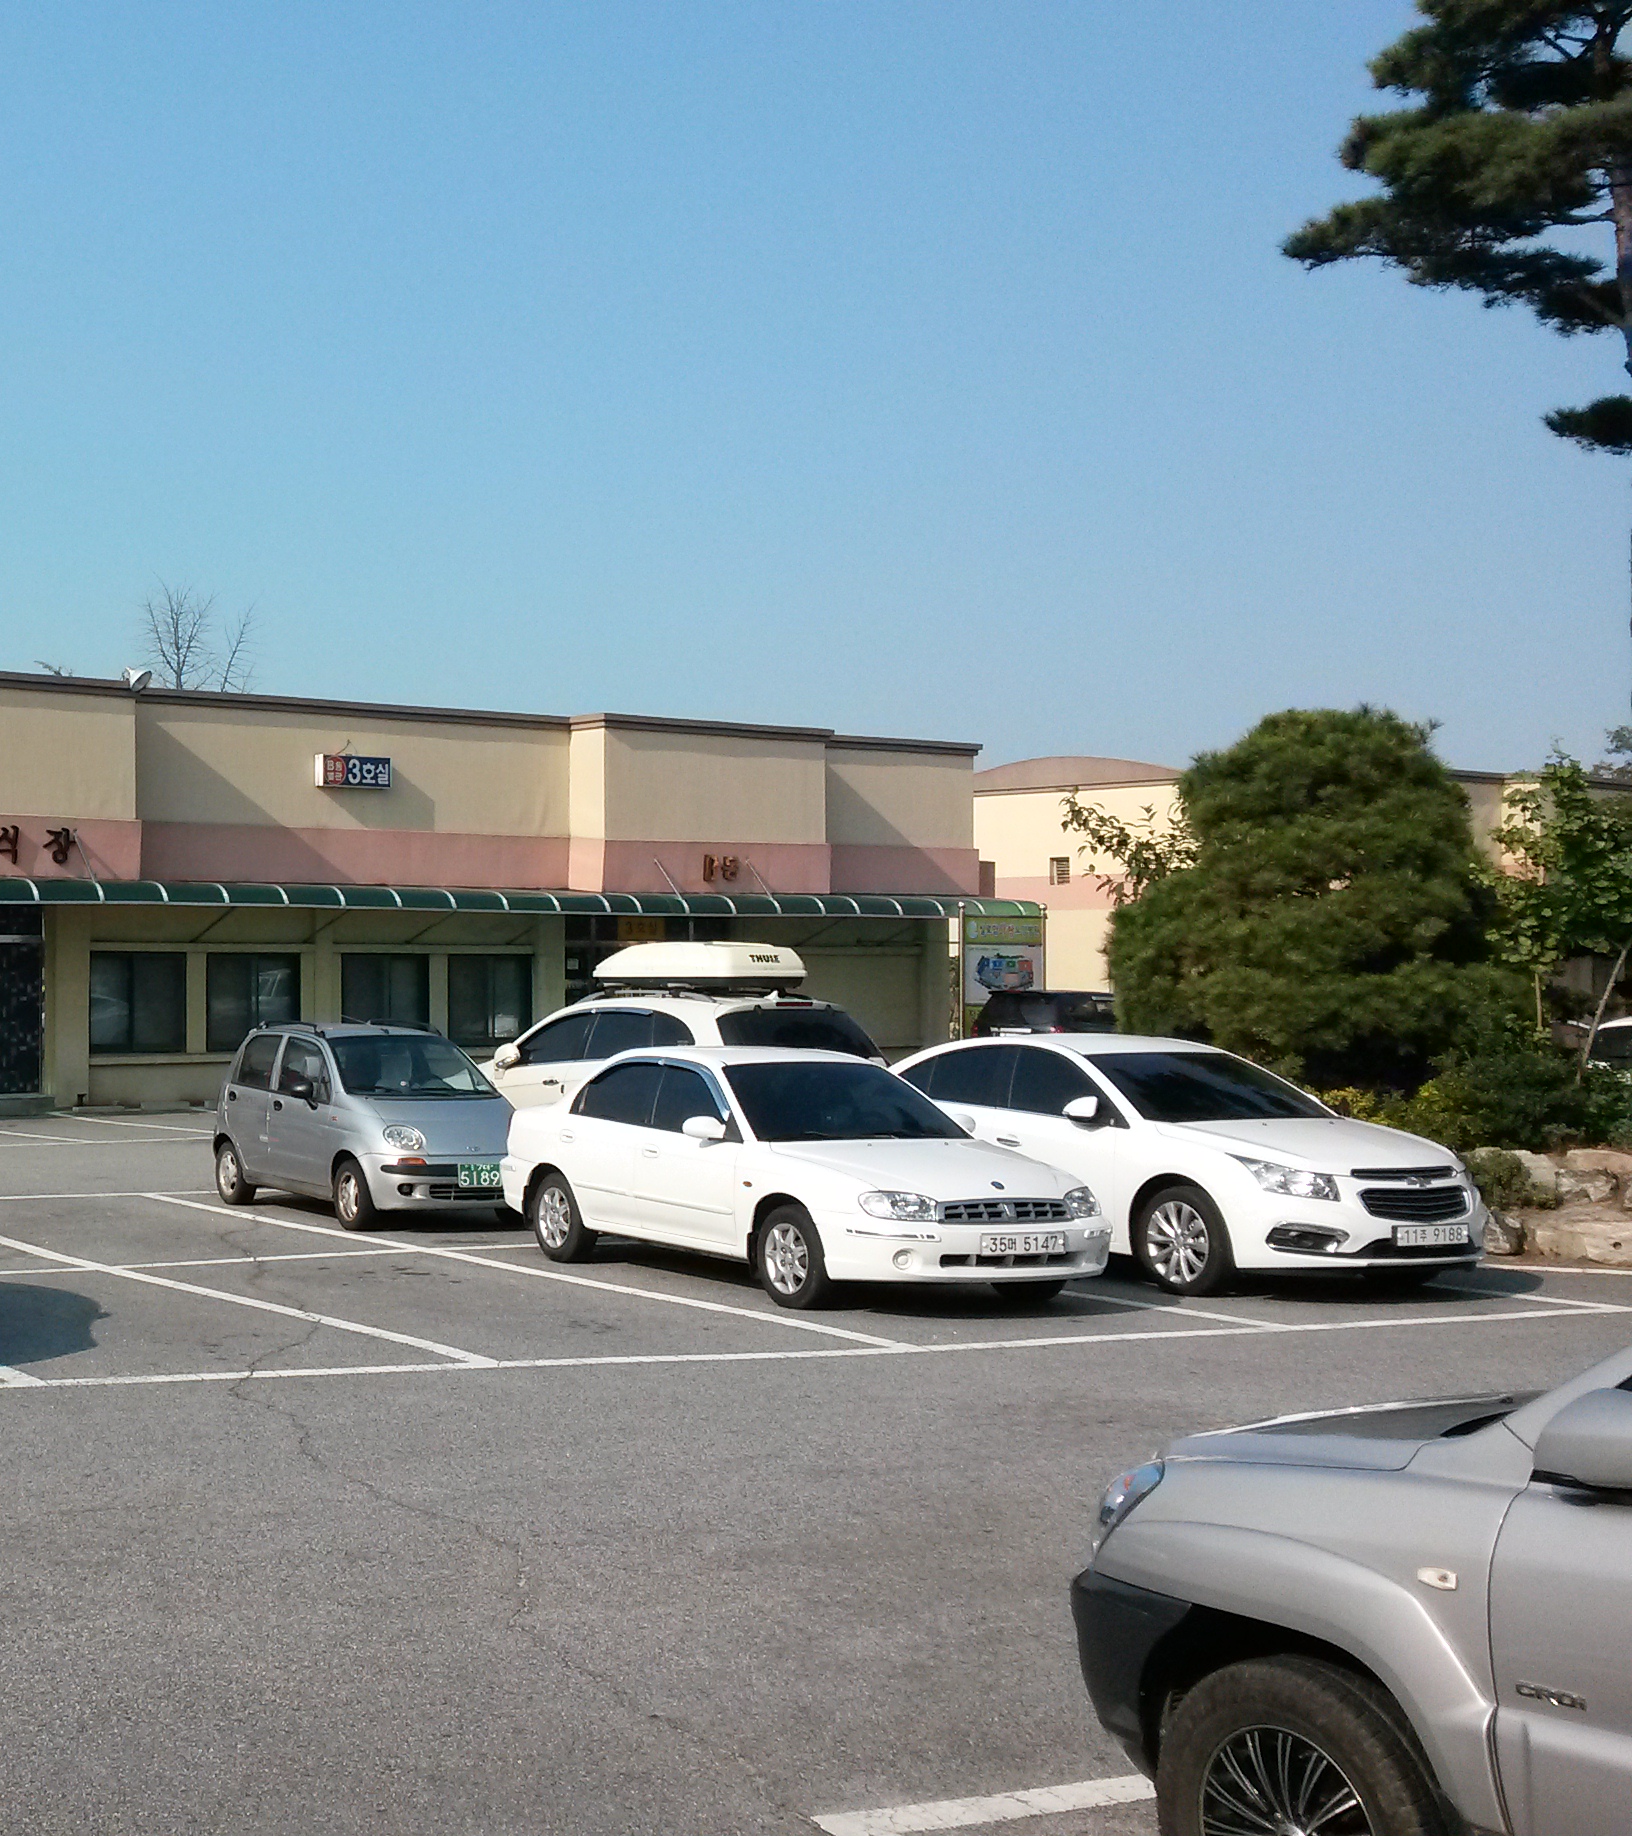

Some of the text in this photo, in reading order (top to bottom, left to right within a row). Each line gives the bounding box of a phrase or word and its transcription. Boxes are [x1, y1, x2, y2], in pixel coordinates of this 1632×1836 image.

[348, 758, 389, 785] 3호실
[749, 954, 780, 963] THULE
[460, 1170, 500, 1186] 5189
[1404, 1226, 1463, 1243] 11주 9188
[989, 1235, 1058, 1253] 35머 5147
